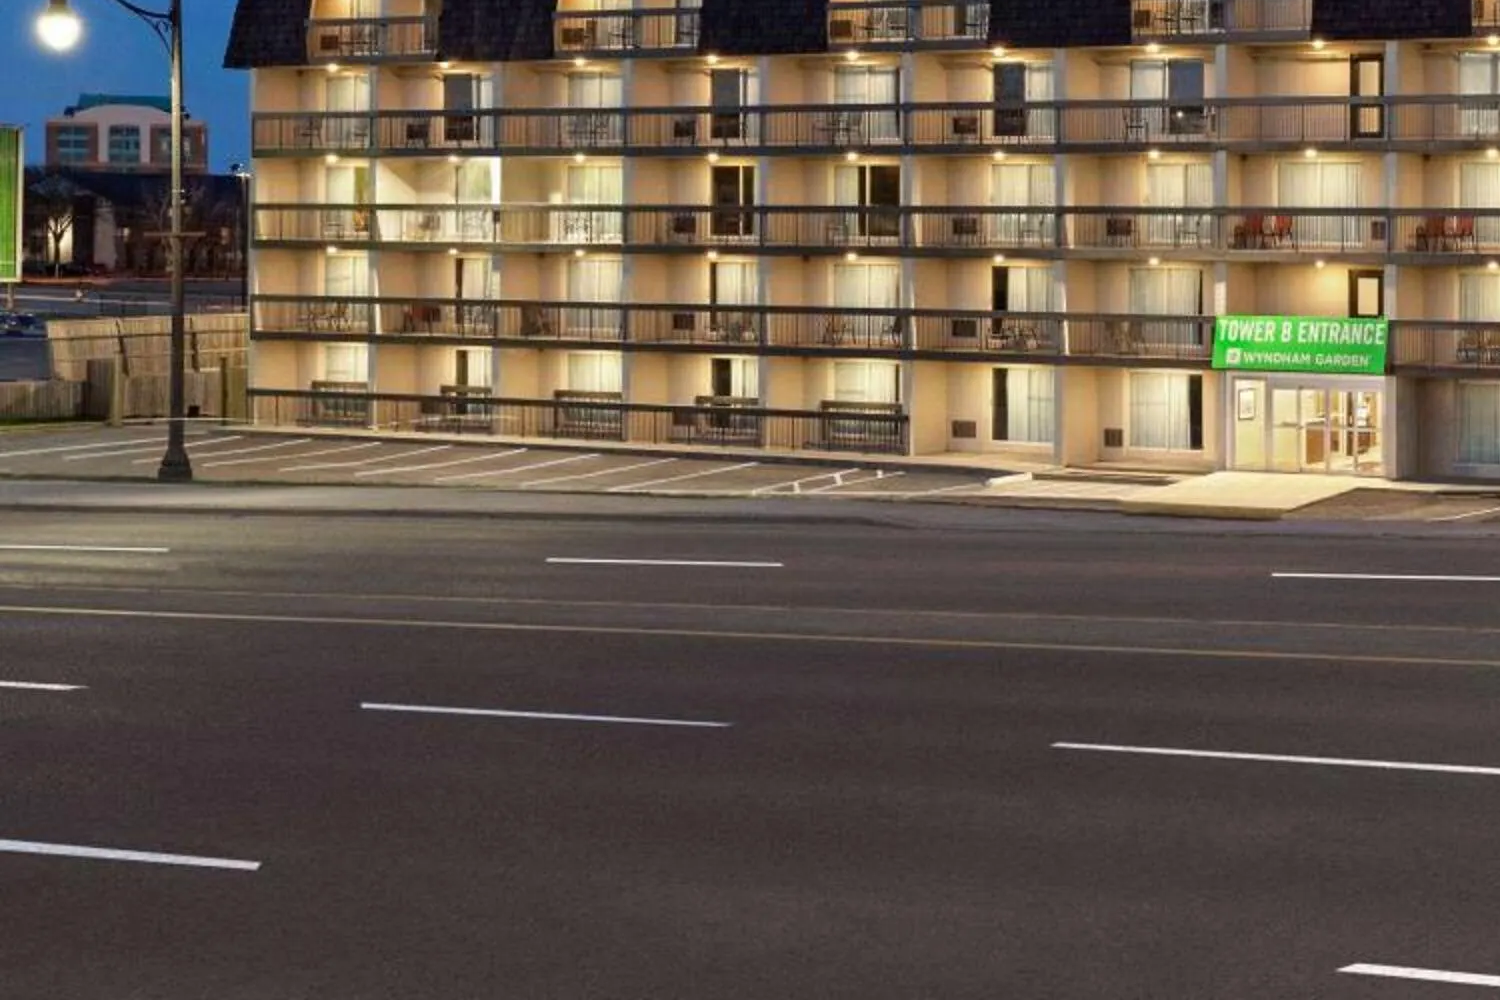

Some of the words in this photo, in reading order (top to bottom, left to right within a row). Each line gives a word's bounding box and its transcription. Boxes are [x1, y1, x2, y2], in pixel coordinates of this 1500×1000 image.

[1218, 320, 1276, 342] TOWER
[1298, 322, 1385, 345] ENTRANCE
[1244, 351, 1311, 364] WYNDHAM
[1315, 353, 1369, 367] GARDEN
